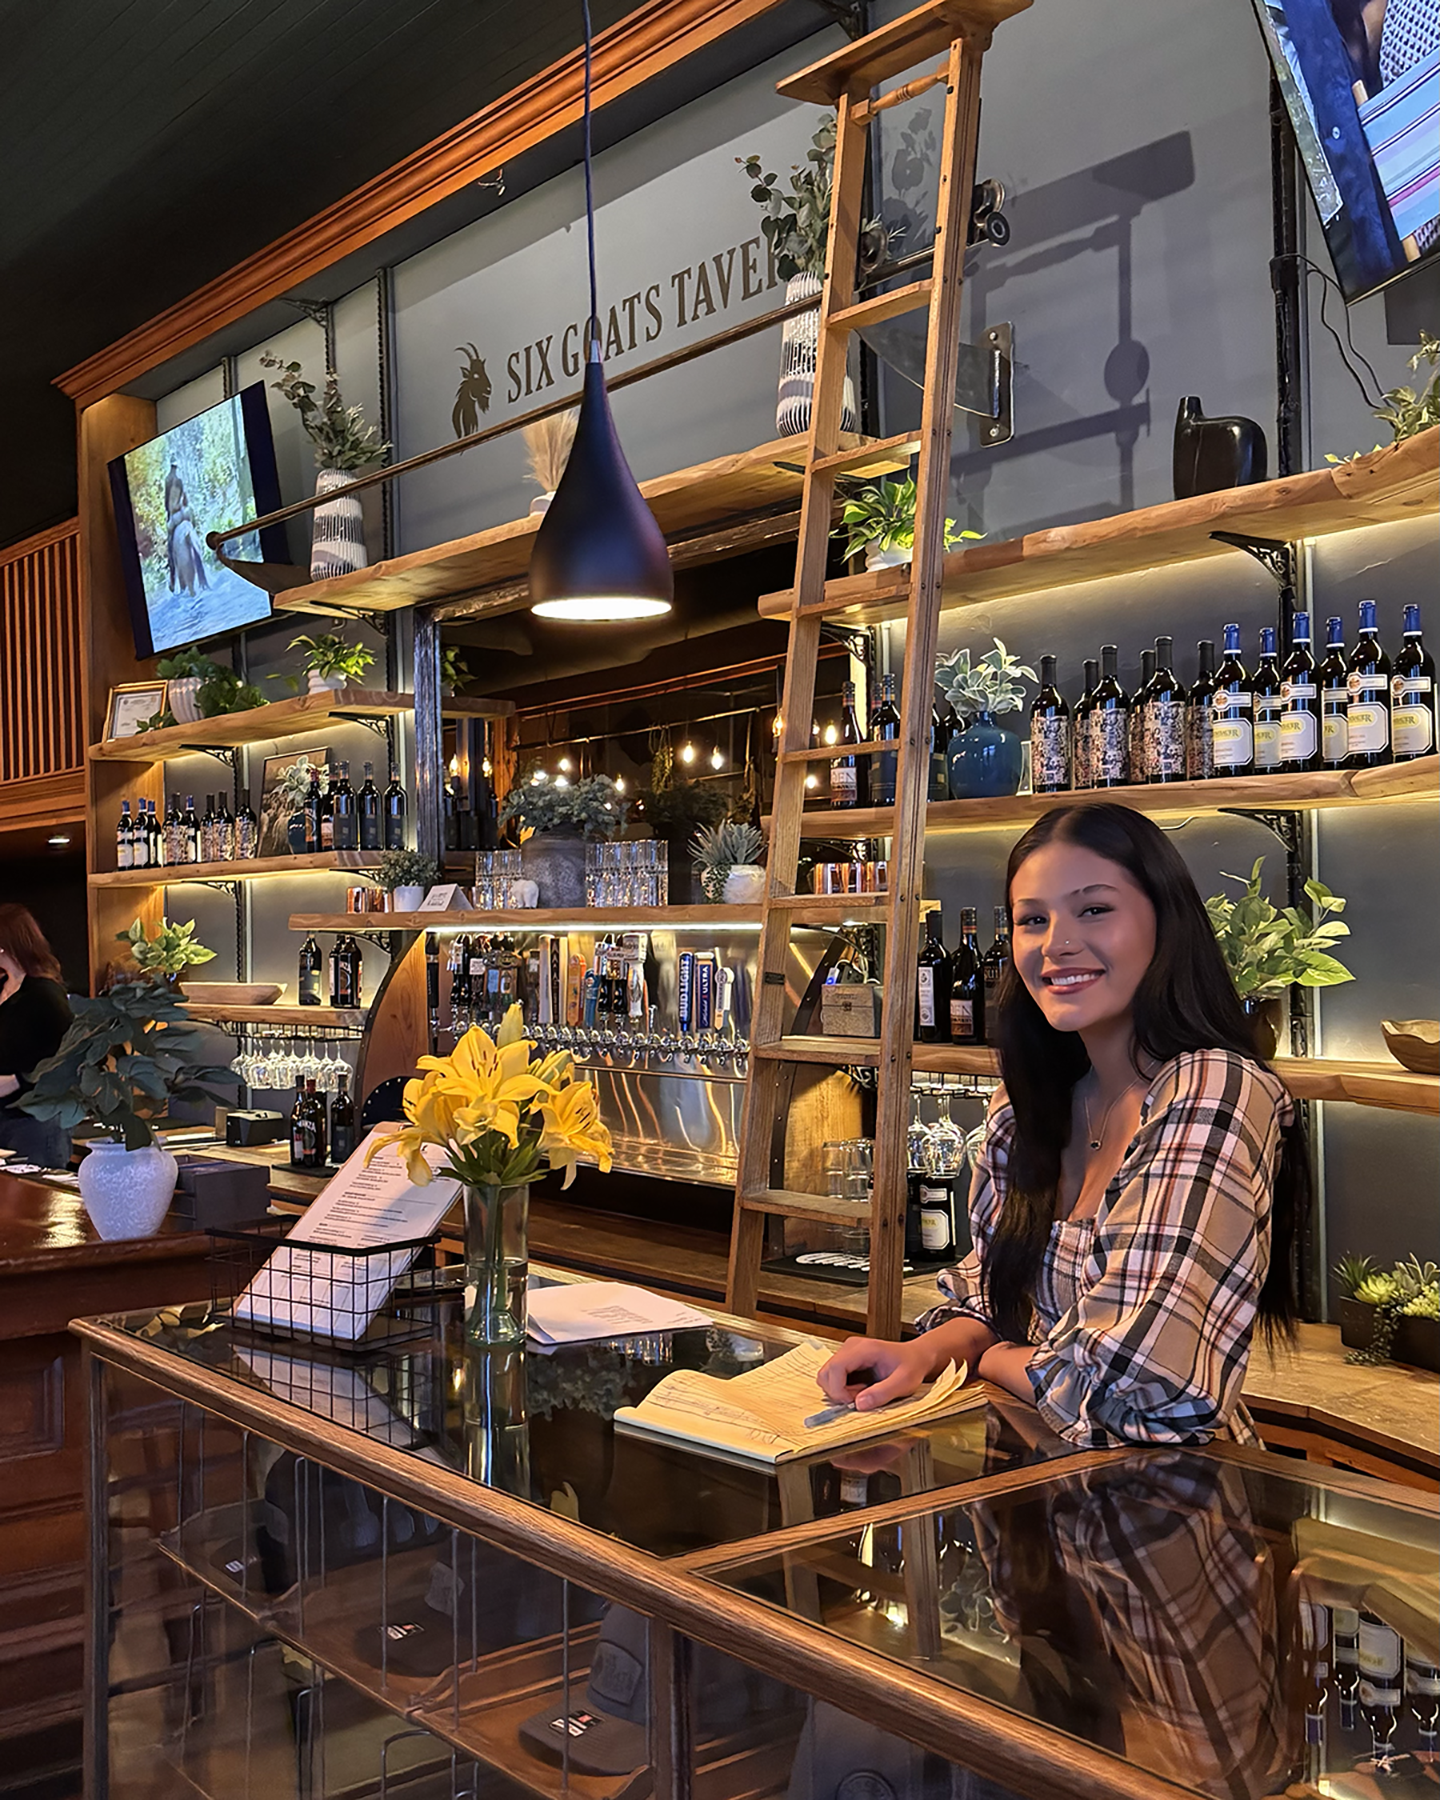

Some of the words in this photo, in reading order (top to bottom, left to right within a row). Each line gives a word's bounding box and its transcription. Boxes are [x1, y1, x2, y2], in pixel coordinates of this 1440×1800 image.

[507, 335, 555, 404] SIX
[561, 284, 663, 378] GOATS
[679, 959, 689, 993] LIGHT
[679, 993, 688, 1018] BUD
